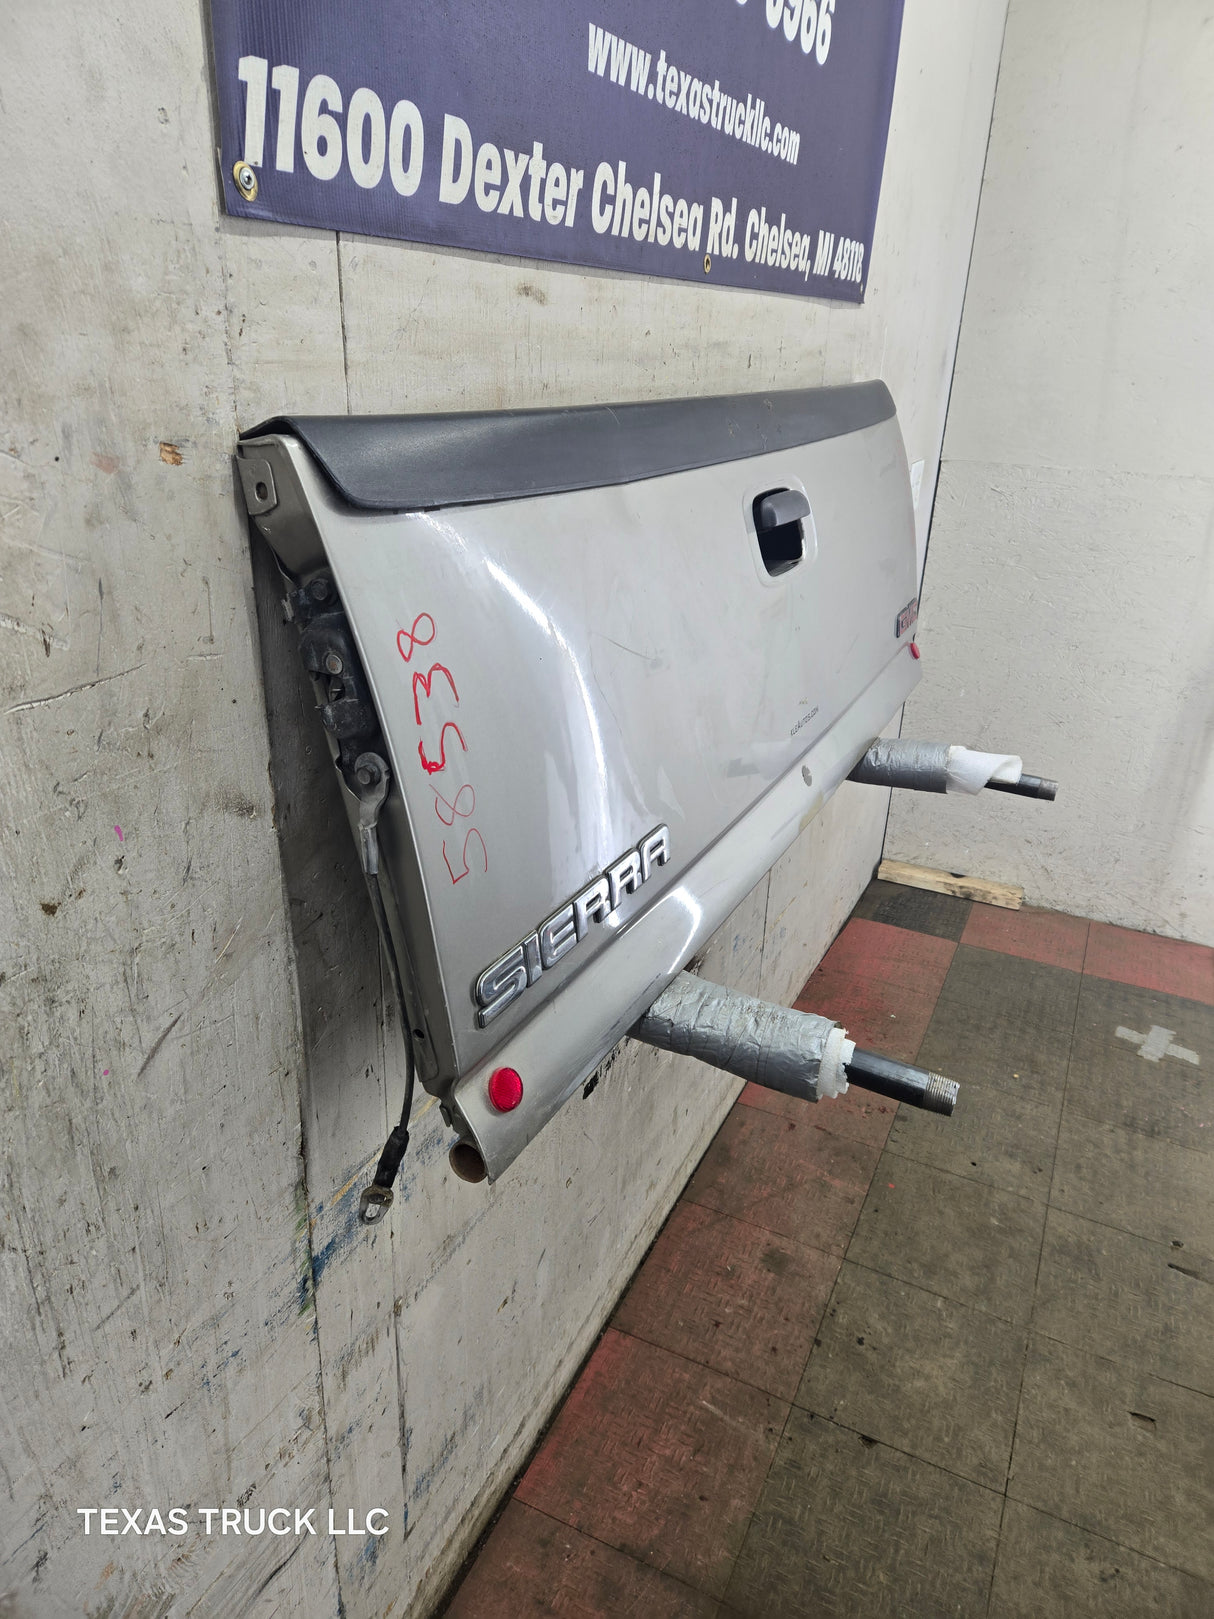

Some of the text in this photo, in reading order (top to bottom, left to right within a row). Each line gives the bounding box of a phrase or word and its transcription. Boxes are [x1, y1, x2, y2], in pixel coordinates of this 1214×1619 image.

[238, 55, 865, 283] 11600 Dexter Chelsea Rd. Chelsea, MI 48118
[587, 22, 800, 165] www.texastruckllc.com
[396, 612, 488, 885] 58538
[474, 822, 672, 1028] SIERRA
